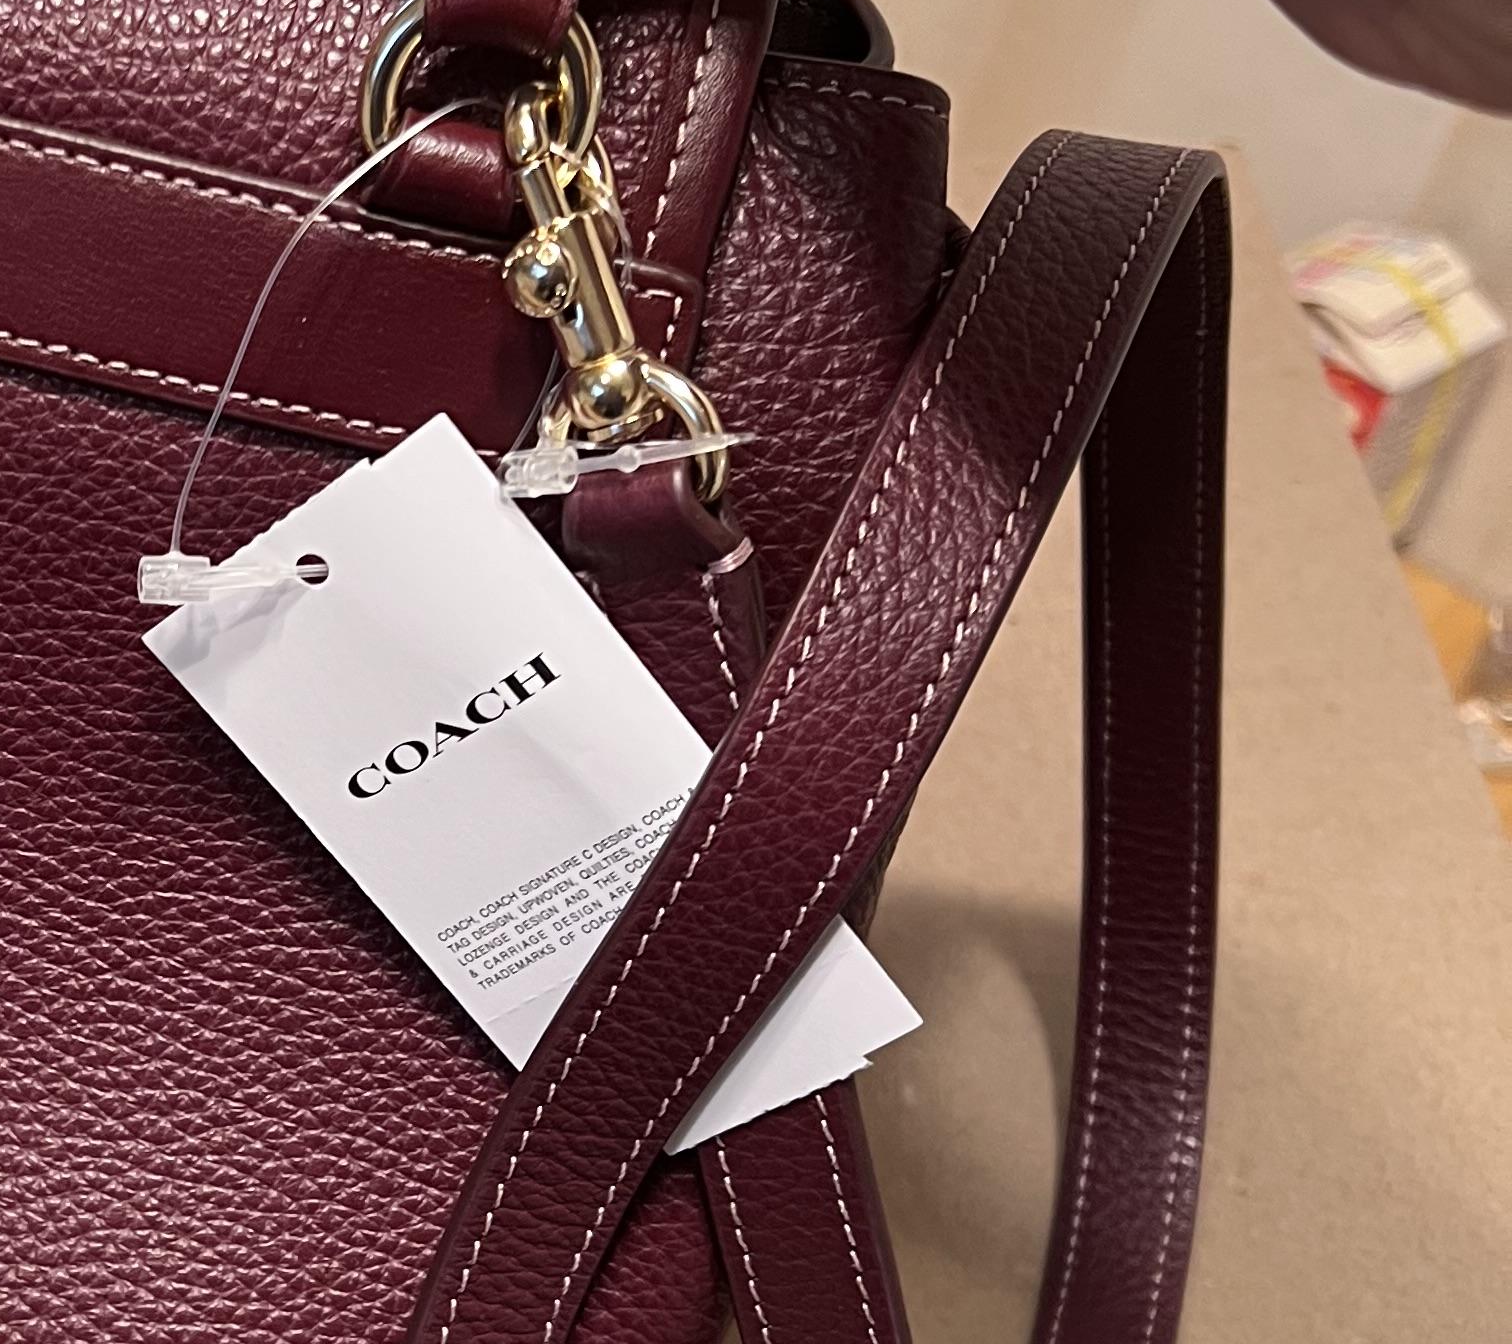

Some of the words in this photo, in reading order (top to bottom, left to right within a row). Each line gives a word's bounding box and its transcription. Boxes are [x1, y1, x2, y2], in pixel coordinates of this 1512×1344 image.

[347, 651, 562, 800] COACH
[479, 892, 519, 918] COACH
[518, 855, 583, 896] SIGNATURE
[581, 848, 594, 860] C
[641, 794, 686, 826] COACH
[447, 937, 471, 954] TAG
[457, 932, 511, 967] LOZENGE
[514, 906, 560, 935] DESIGN
[564, 888, 590, 907] AND
[592, 871, 621, 890] THE
[468, 968, 479, 978] &
[483, 929, 548, 970] CARRIAGE
[552, 899, 604, 932] DESIGN
[608, 881, 636, 901] ARE
[477, 943, 557, 990] TRADEMARKS
[559, 931, 578, 946] OF
